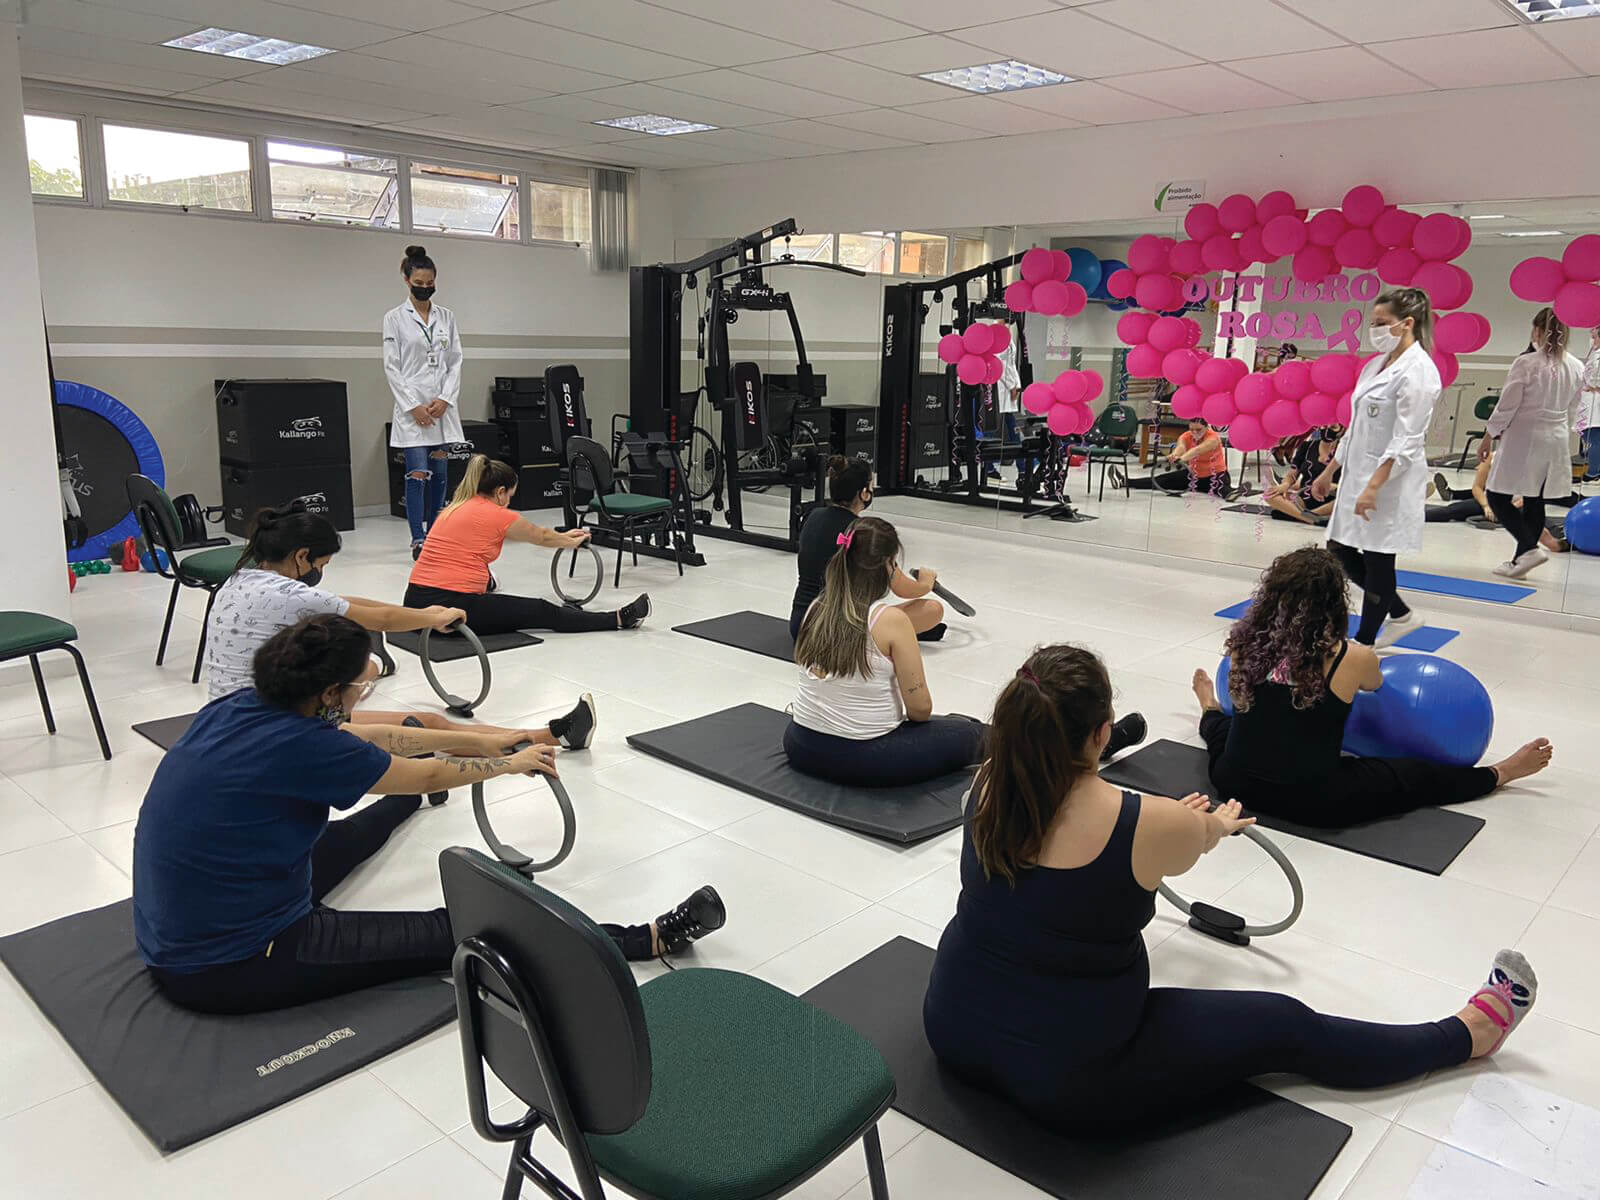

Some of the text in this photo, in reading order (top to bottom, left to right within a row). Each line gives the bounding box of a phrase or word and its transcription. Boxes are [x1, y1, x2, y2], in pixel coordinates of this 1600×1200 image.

[1182, 273, 1380, 302] OUTUBRO
[1217, 310, 1327, 340] ROSA
[279, 430, 317, 439] Kallango
